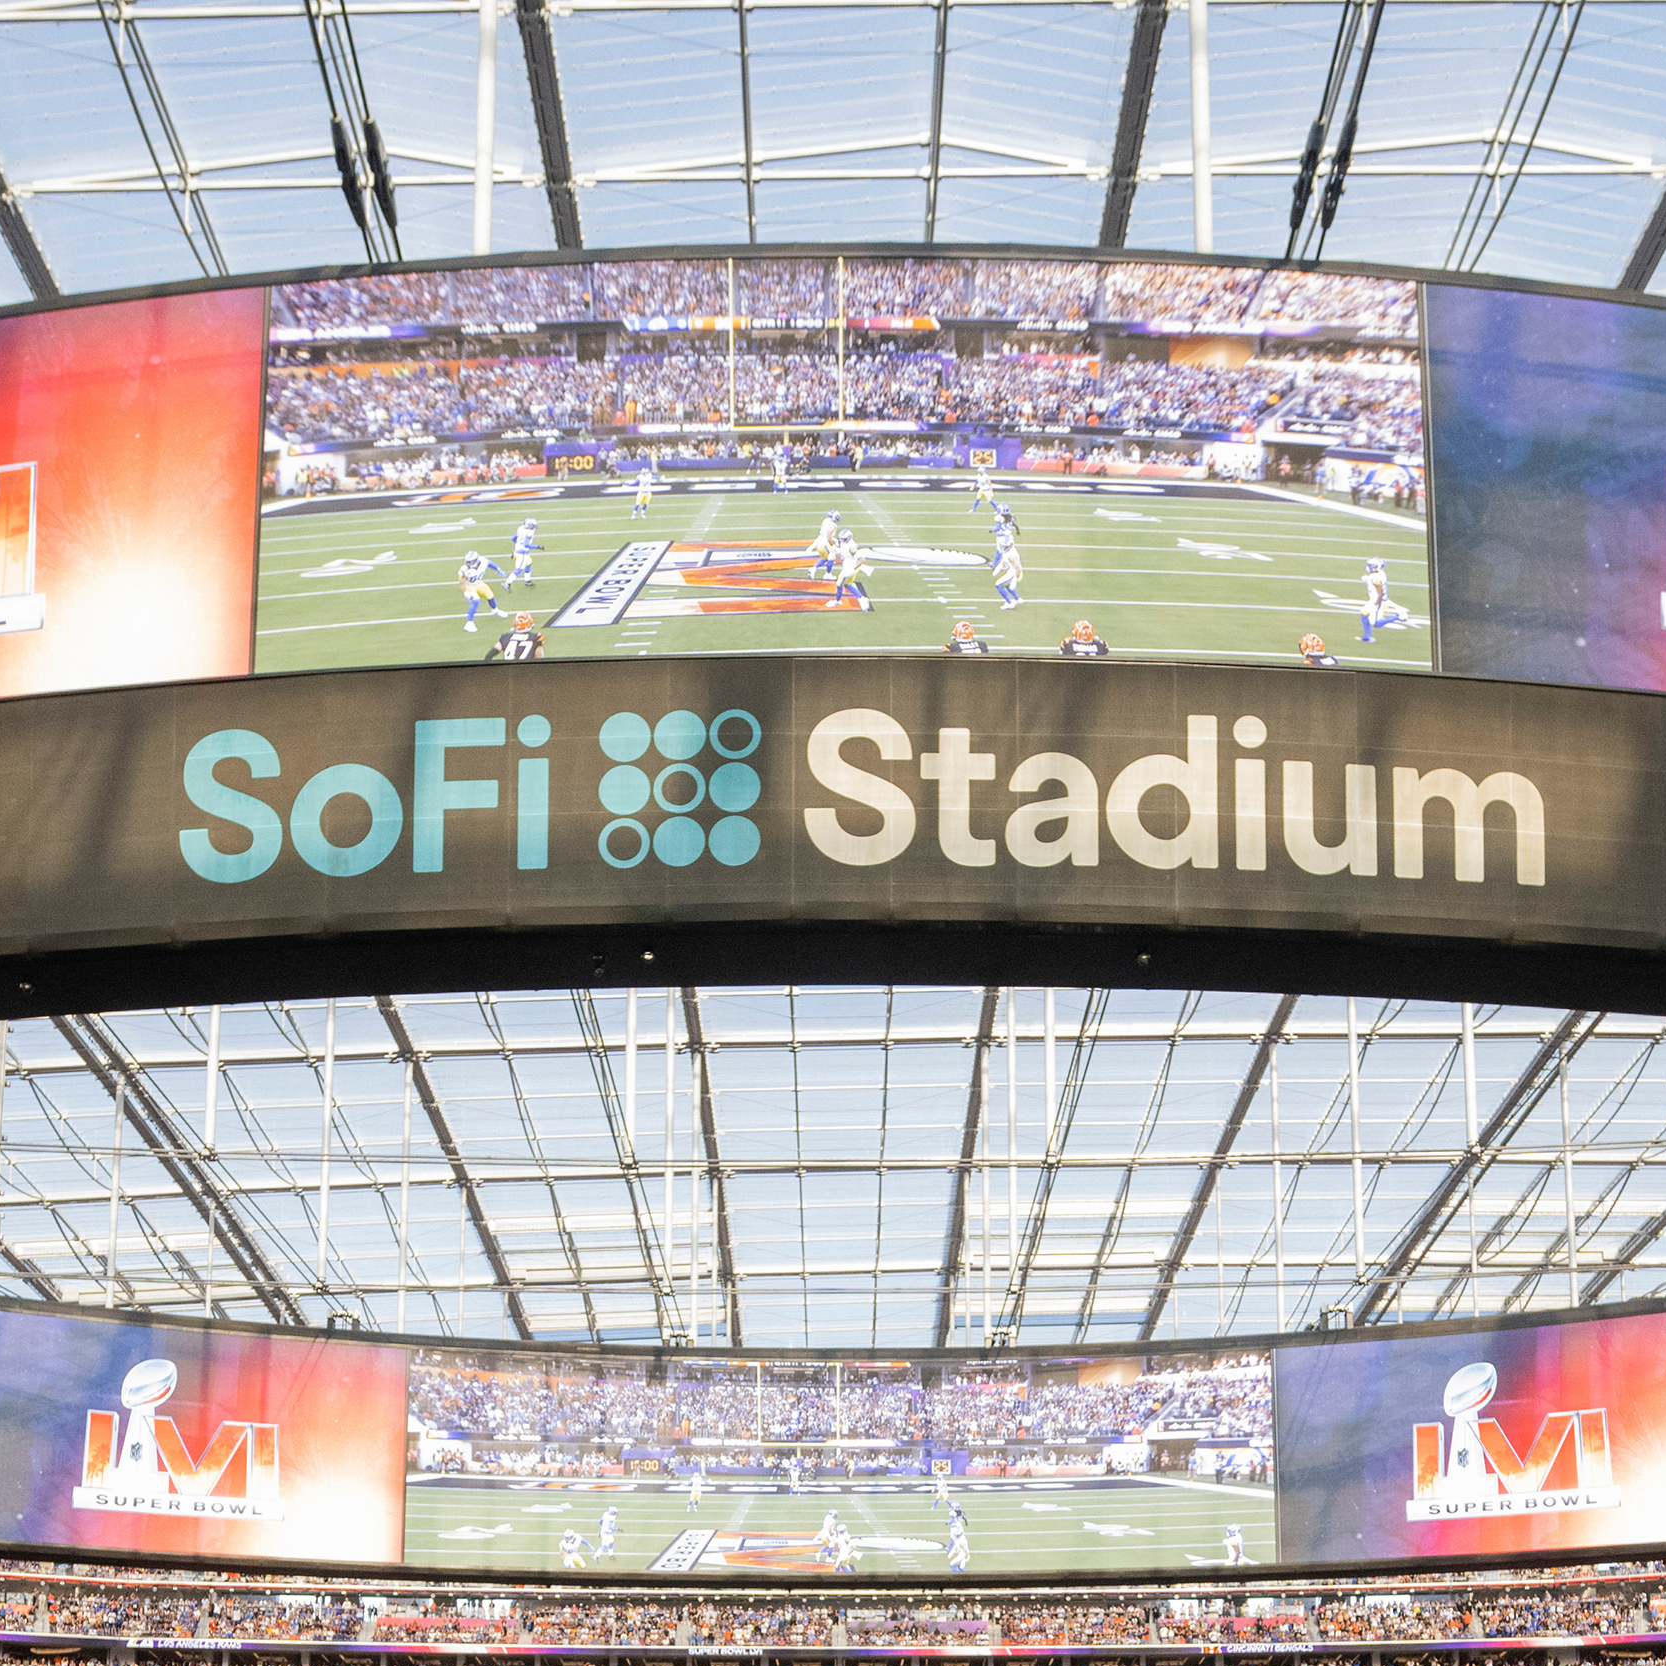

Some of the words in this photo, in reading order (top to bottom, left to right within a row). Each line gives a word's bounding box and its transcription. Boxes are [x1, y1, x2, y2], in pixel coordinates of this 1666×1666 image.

[574, 579, 632, 615] BOWL
[180, 712, 551, 884] SoFi
[804, 707, 1547, 887] Stadium
[95, 1493, 181, 1511] SUPER
[193, 1501, 264, 1517] BOWL
[1428, 1499, 1513, 1516] SUPER
[1525, 1494, 1598, 1510] BOWL
